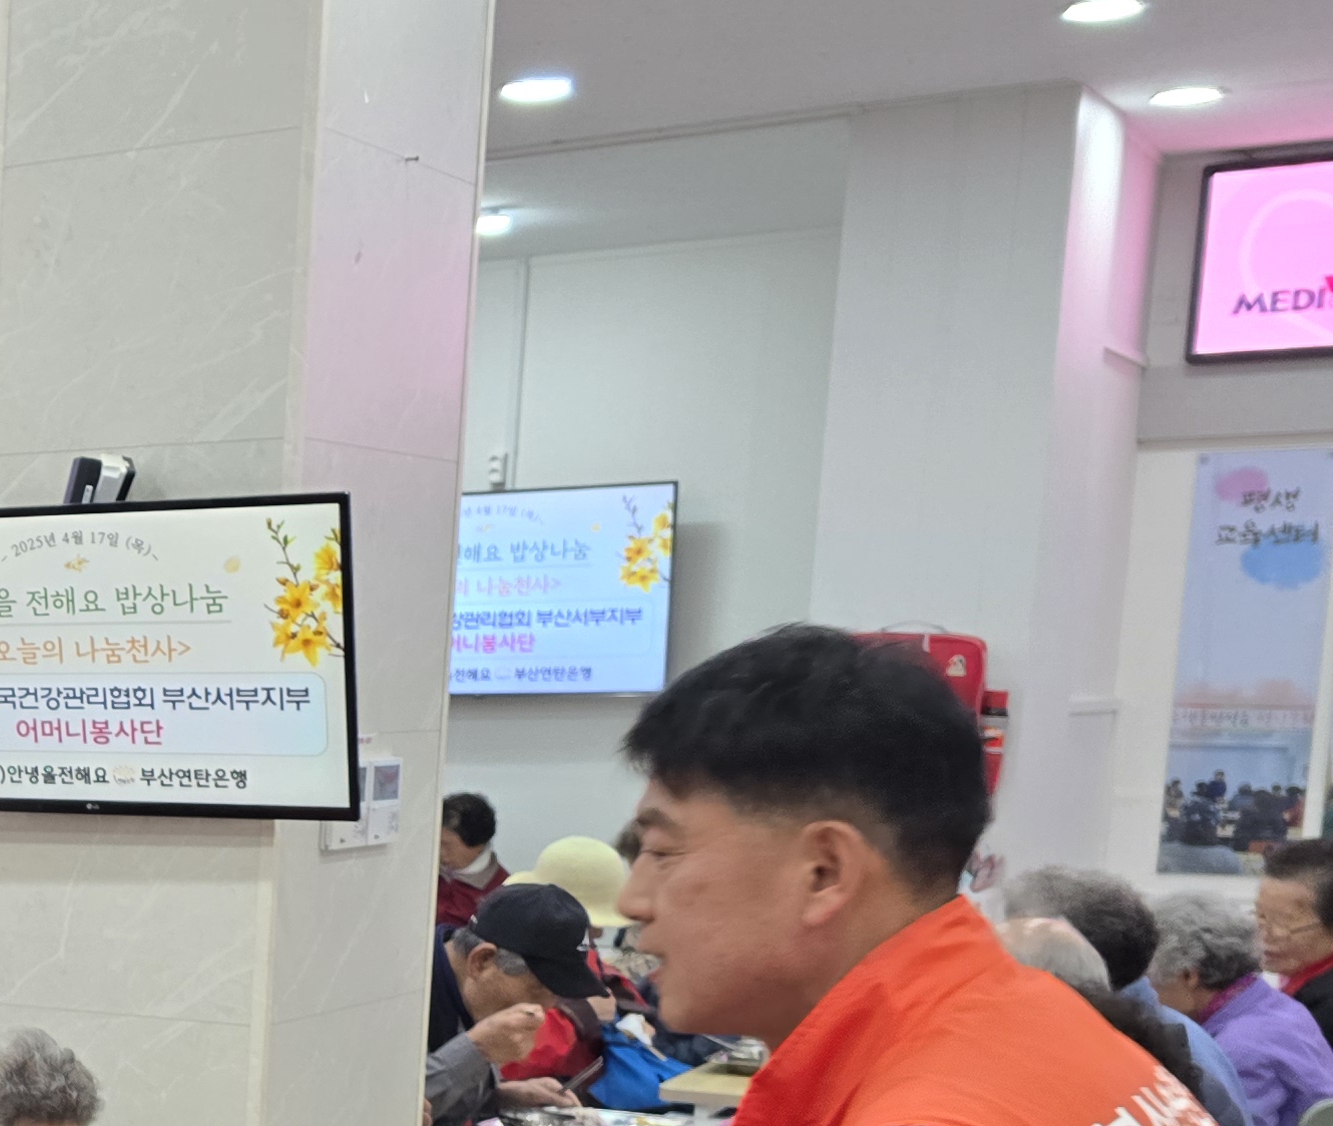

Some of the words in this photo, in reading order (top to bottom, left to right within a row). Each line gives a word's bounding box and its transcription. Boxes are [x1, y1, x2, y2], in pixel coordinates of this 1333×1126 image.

[10, 531, 57, 557] 2025년
[61, 530, 84, 546] 4월
[90, 531, 120, 548] 17일
[125, 535, 152, 557] (목)
[25, 585, 107, 618] 전해요
[114, 582, 230, 617] 밥상나눔
[74, 633, 193, 665] 나눔천사>
[161, 685, 311, 712] 부산서부지부
[15, 717, 164, 746] 어머니봉사단
[139, 767, 249, 790] 부산연탄은행
